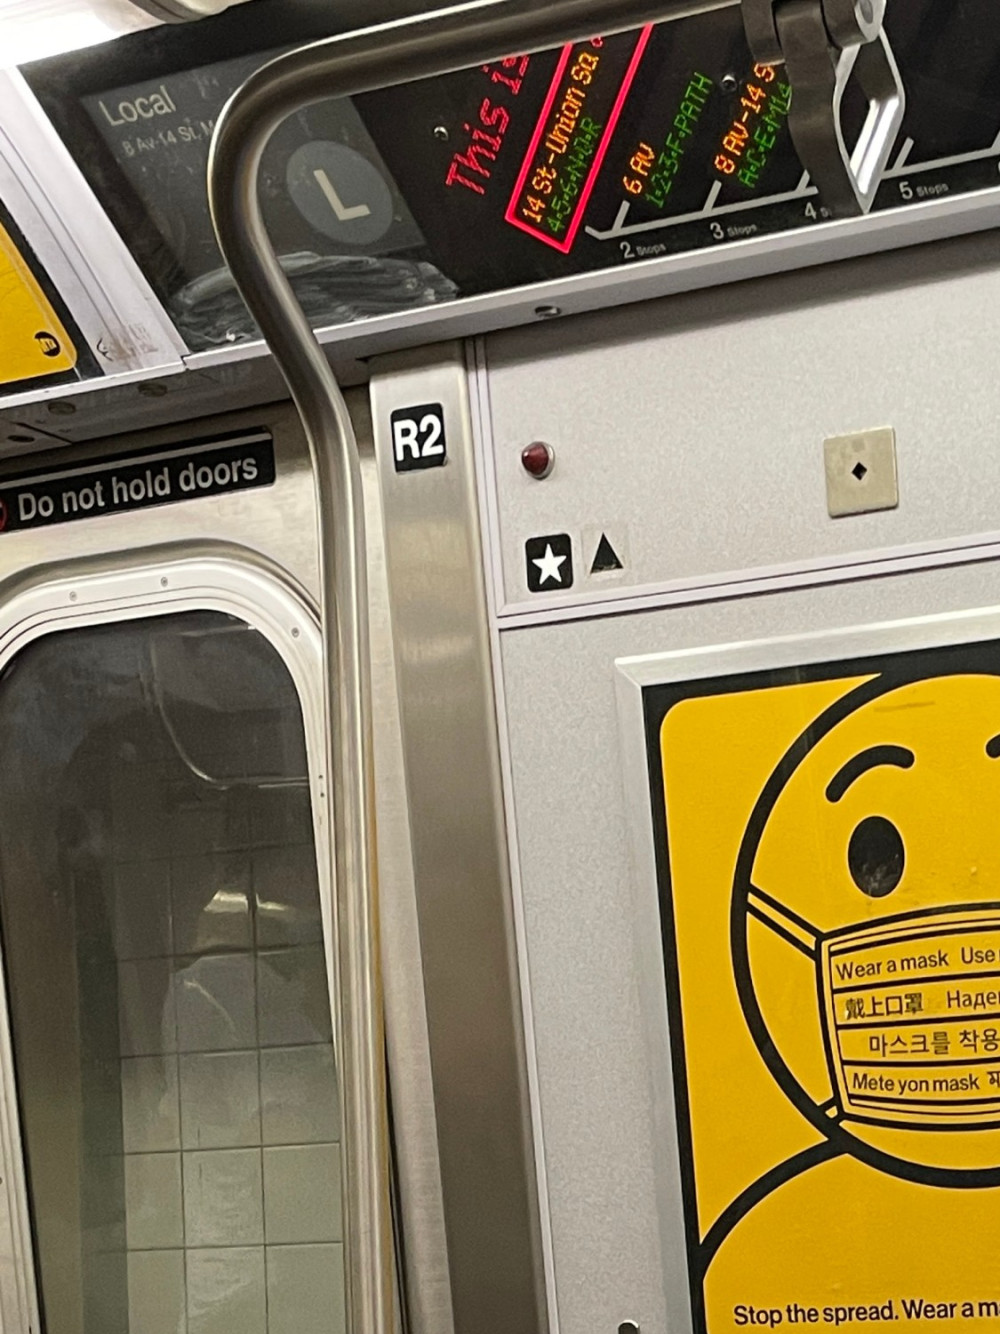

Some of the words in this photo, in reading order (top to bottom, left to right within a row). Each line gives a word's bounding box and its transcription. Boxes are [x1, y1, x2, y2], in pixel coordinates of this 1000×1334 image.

[98, 84, 177, 127] Local
[714, 154, 736, 175] 8
[754, 63, 775, 83] S
[446, 98, 509, 195] This
[314, 169, 371, 222] L
[622, 175, 643, 194] 6
[900, 181, 914, 200] 5
[916, 182, 949, 197] Stops
[522, 195, 546, 223] 14
[804, 201, 817, 220] 4
[710, 221, 725, 240] 3
[727, 223, 758, 237] Stops
[619, 241, 635, 259] 2
[636, 243, 667, 257] Stops
[393, 413, 444, 461] R2
[18, 493, 55, 521] Do
[62, 483, 105, 514] not
[112, 466, 171, 504] hold
[178, 454, 258, 494] doors
[836, 961, 881, 980] Wear
[887, 960, 897, 973] a
[901, 950, 949, 971] mask
[961, 946, 995, 964] Use
[869, 1031, 951, 1057] 마스크를
[852, 1072, 895, 1091] Mete
[899, 1077, 930, 1095] yon
[933, 1073, 980, 1091] mask
[733, 1305, 783, 1328] Stop
[786, 1303, 819, 1325] the
[823, 1300, 899, 1326] spread.
[901, 1298, 958, 1320] Wear
[962, 1303, 975, 1318] a
